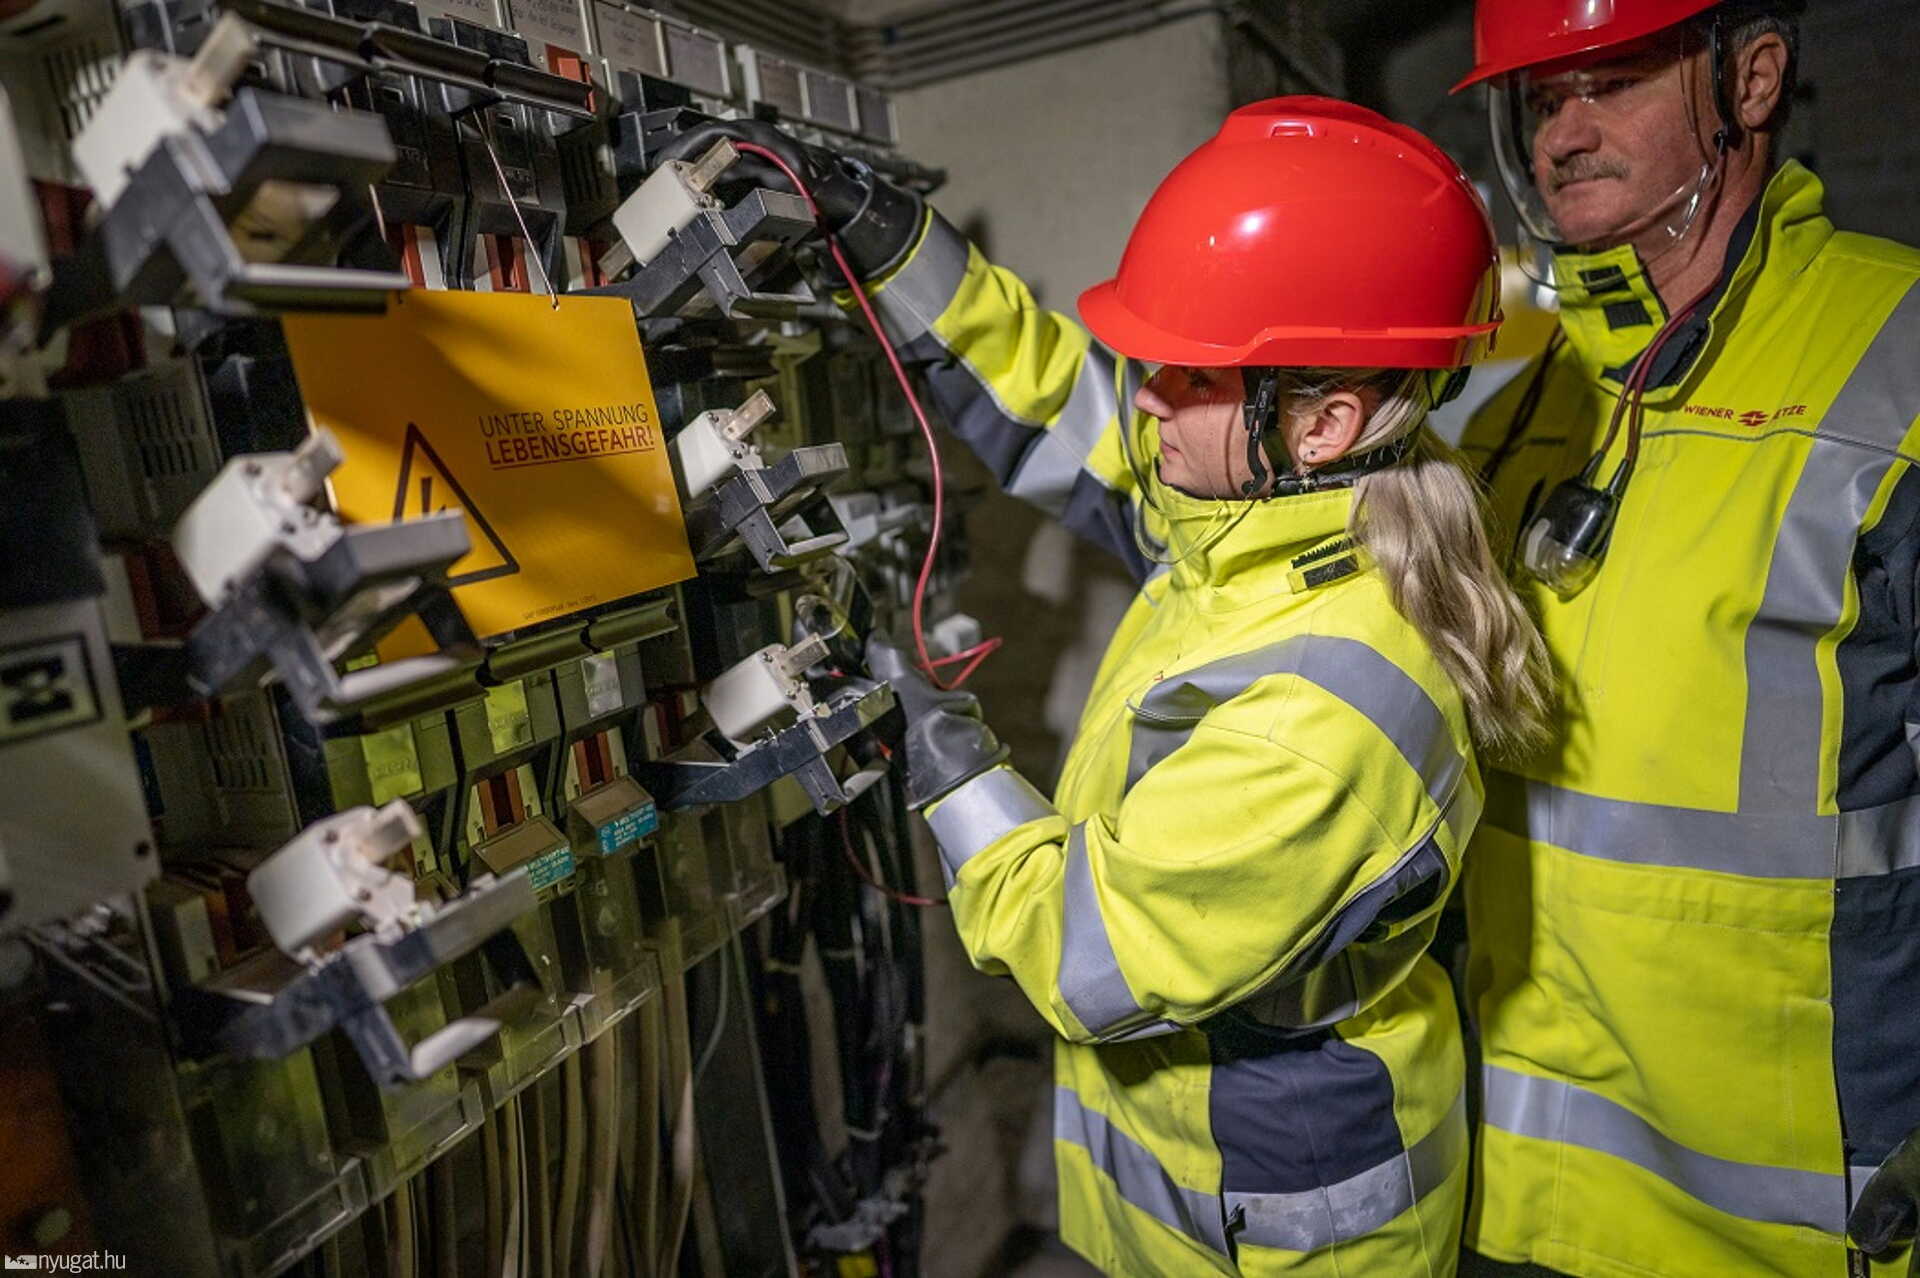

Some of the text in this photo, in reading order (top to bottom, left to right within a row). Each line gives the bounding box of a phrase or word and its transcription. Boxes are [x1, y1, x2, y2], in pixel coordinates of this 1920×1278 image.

[479, 403, 648, 438] UNTER SPANNUNG
[1684, 405, 1735, 420] WIENER
[485, 425, 655, 464] LEBENSGEFAHR!
